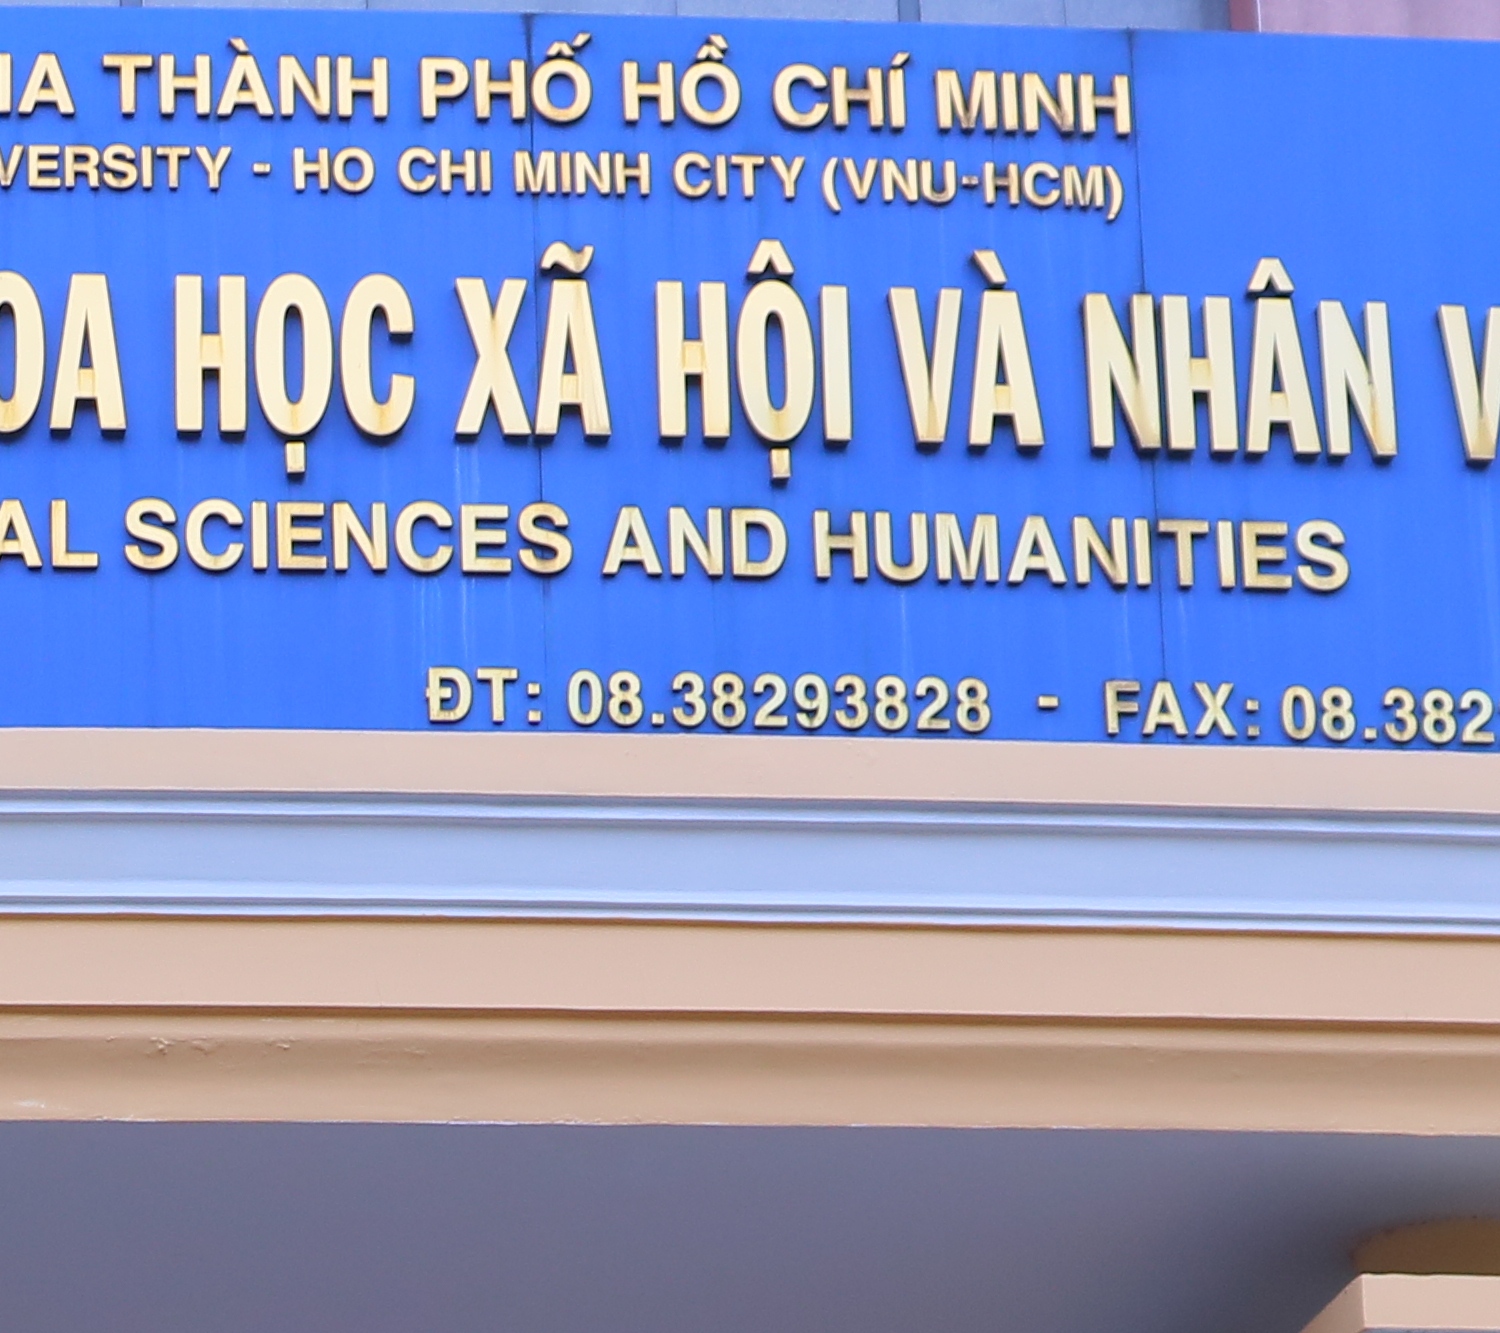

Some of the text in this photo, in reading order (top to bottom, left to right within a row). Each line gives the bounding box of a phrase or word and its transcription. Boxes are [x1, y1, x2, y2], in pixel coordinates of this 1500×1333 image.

[101, 36, 390, 120] THÀNH
[418, 31, 594, 124] PHỐ
[620, 33, 742, 128] HỒ
[771, 51, 911, 131] CHÍ
[933, 68, 1134, 137] MINH
[291, 145, 376, 194] HO
[396, 145, 494, 194] CHI
[512, 149, 652, 196] MINH
[671, 150, 806, 200] CITY
[820, 156, 1125, 221] (VNU-HCM)
[173, 271, 417, 477] HỌC
[454, 240, 612, 441] XÃ
[654, 238, 854, 482] HỘI
[887, 248, 1045, 450] VÀ
[1081, 256, 1398, 460] NHÂN
[123, 496, 574, 578] SCIENCES
[601, 505, 789, 581] AND
[811, 508, 1350, 594] HUMANITIES
[424, 665, 543, 723] ĐT:
[566, 668, 992, 735] 08.38293828
[1103, 679, 1261, 738] FAX:
